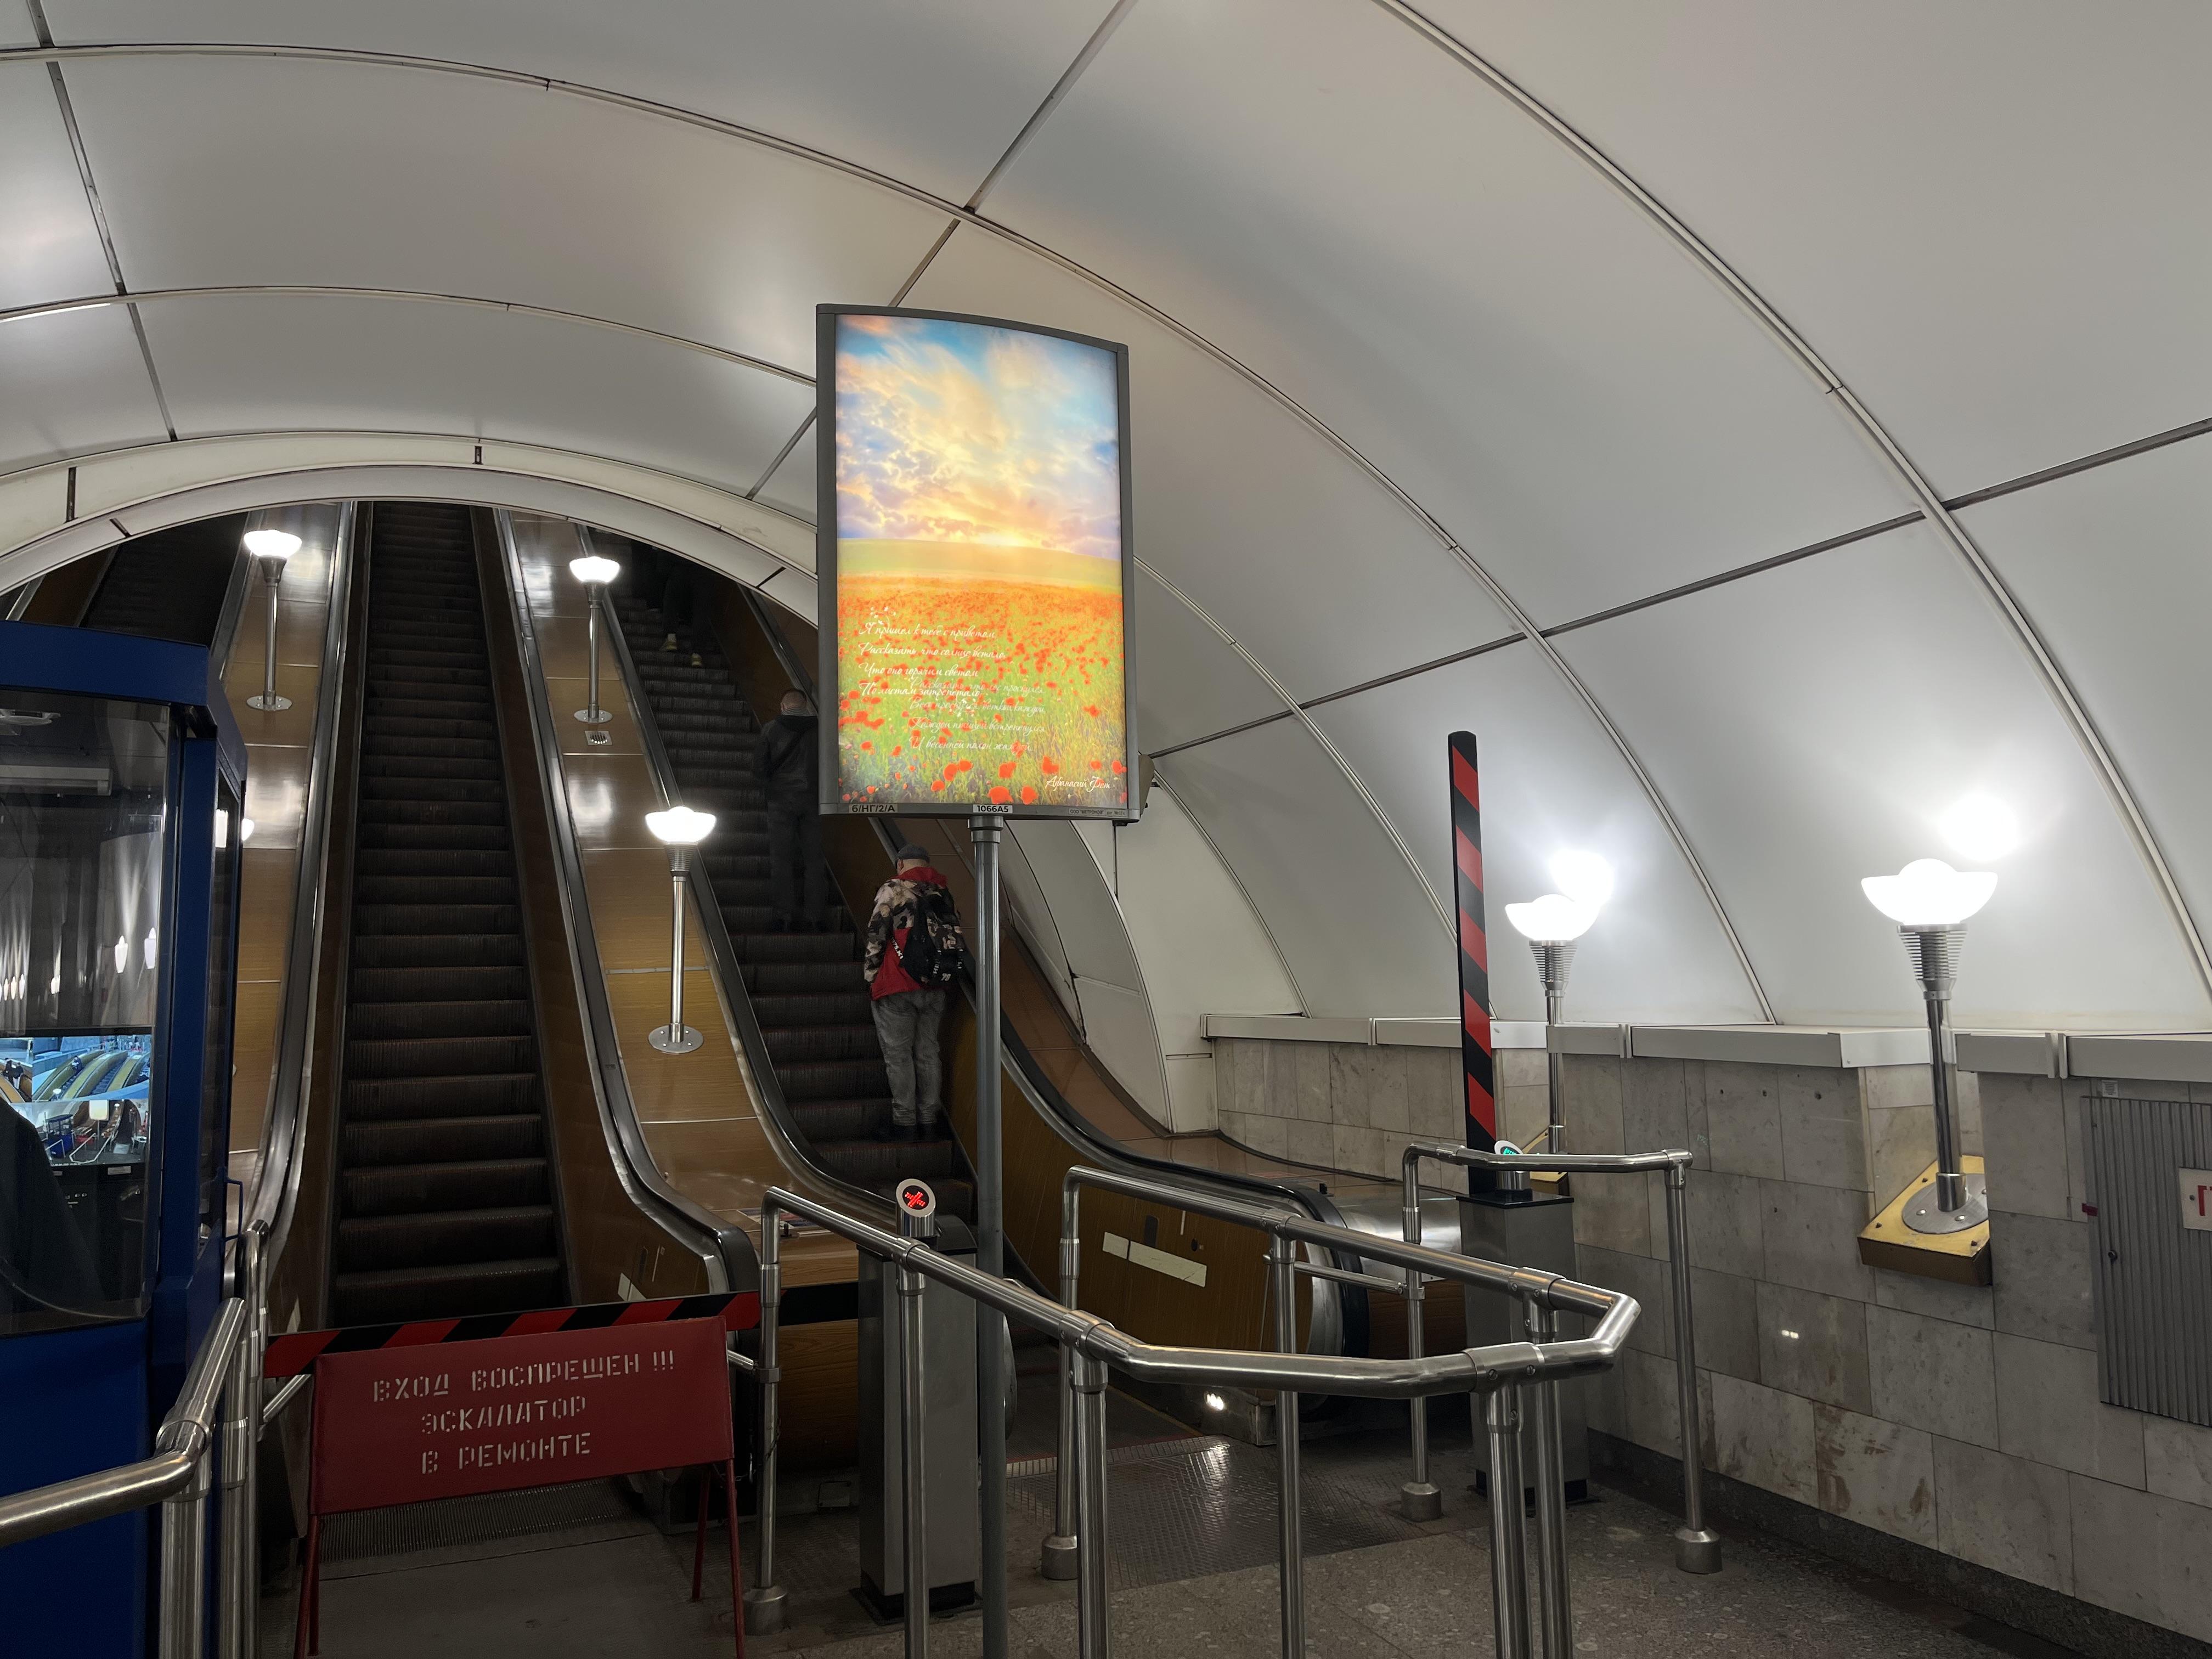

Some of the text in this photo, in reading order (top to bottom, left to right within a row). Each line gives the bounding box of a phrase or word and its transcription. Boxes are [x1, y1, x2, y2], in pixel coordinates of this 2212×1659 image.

[859, 622, 877, 634] Я
[874, 627, 911, 639] пришел
[940, 648, 971, 659] солнце
[858, 662, 885, 678] Что
[905, 667, 942, 680] горячим
[944, 664, 978, 676] светом
[859, 682, 877, 696] По
[1045, 775, 1111, 792] Афанасий Фет
[374, 1374, 449, 1402] ВХОД
[471, 1354, 639, 1392] ВОСПРЕЩЕН
[421, 1396, 585, 1435] ЭСКАЛАТОР
[422, 1432, 591, 1475] В РЕМОНТЕ
